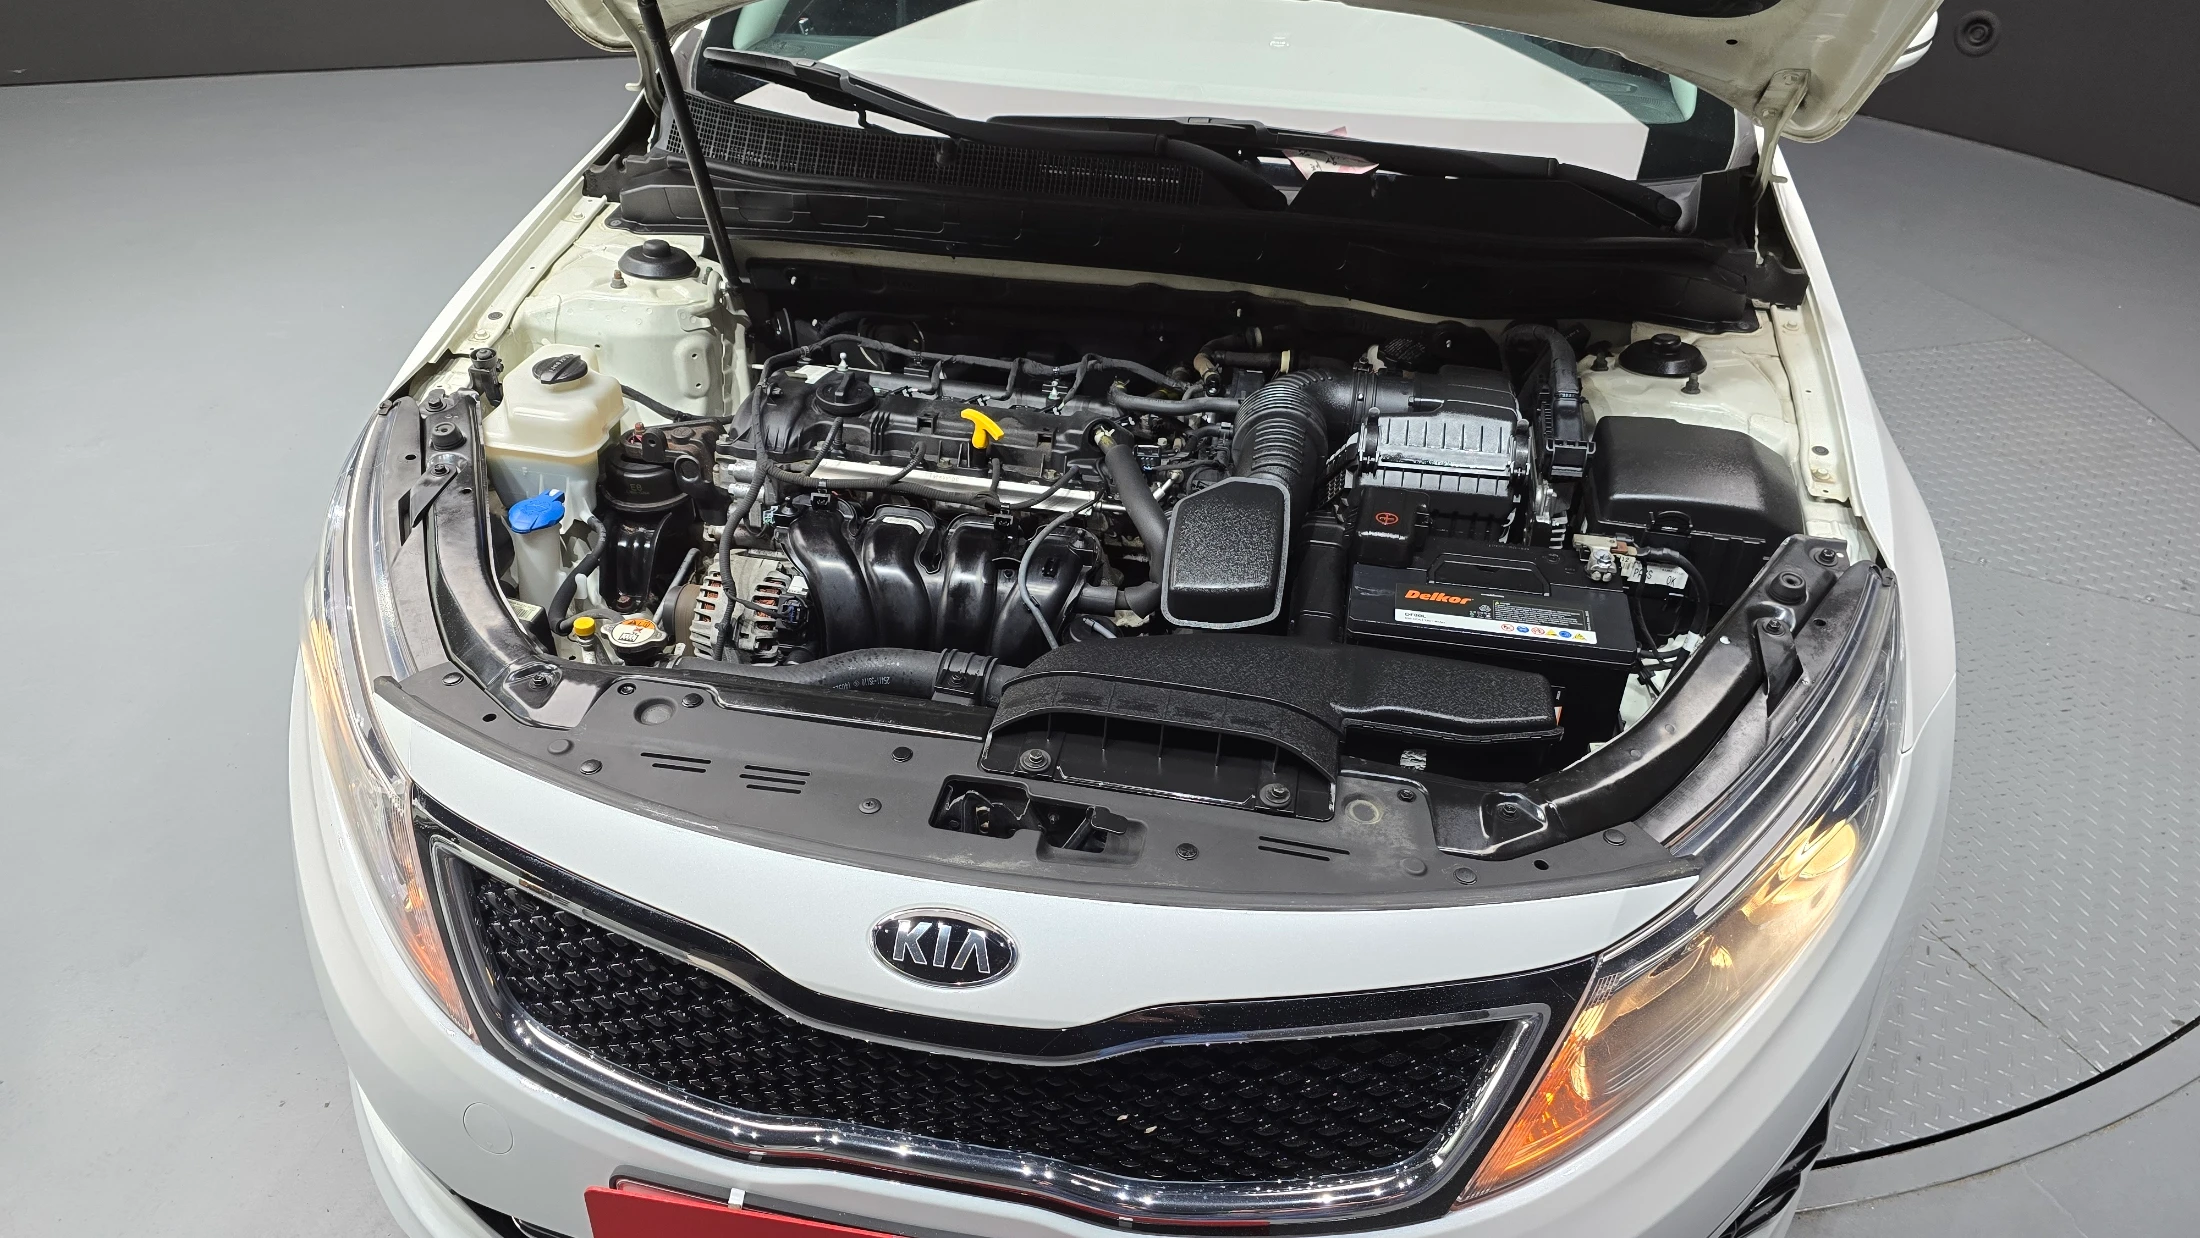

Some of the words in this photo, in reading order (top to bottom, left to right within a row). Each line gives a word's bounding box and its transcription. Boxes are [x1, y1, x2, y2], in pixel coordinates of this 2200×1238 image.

[1666, 575, 1677, 587] OK
[1404, 589, 1472, 605] Delkor
[892, 919, 991, 974] KIA
